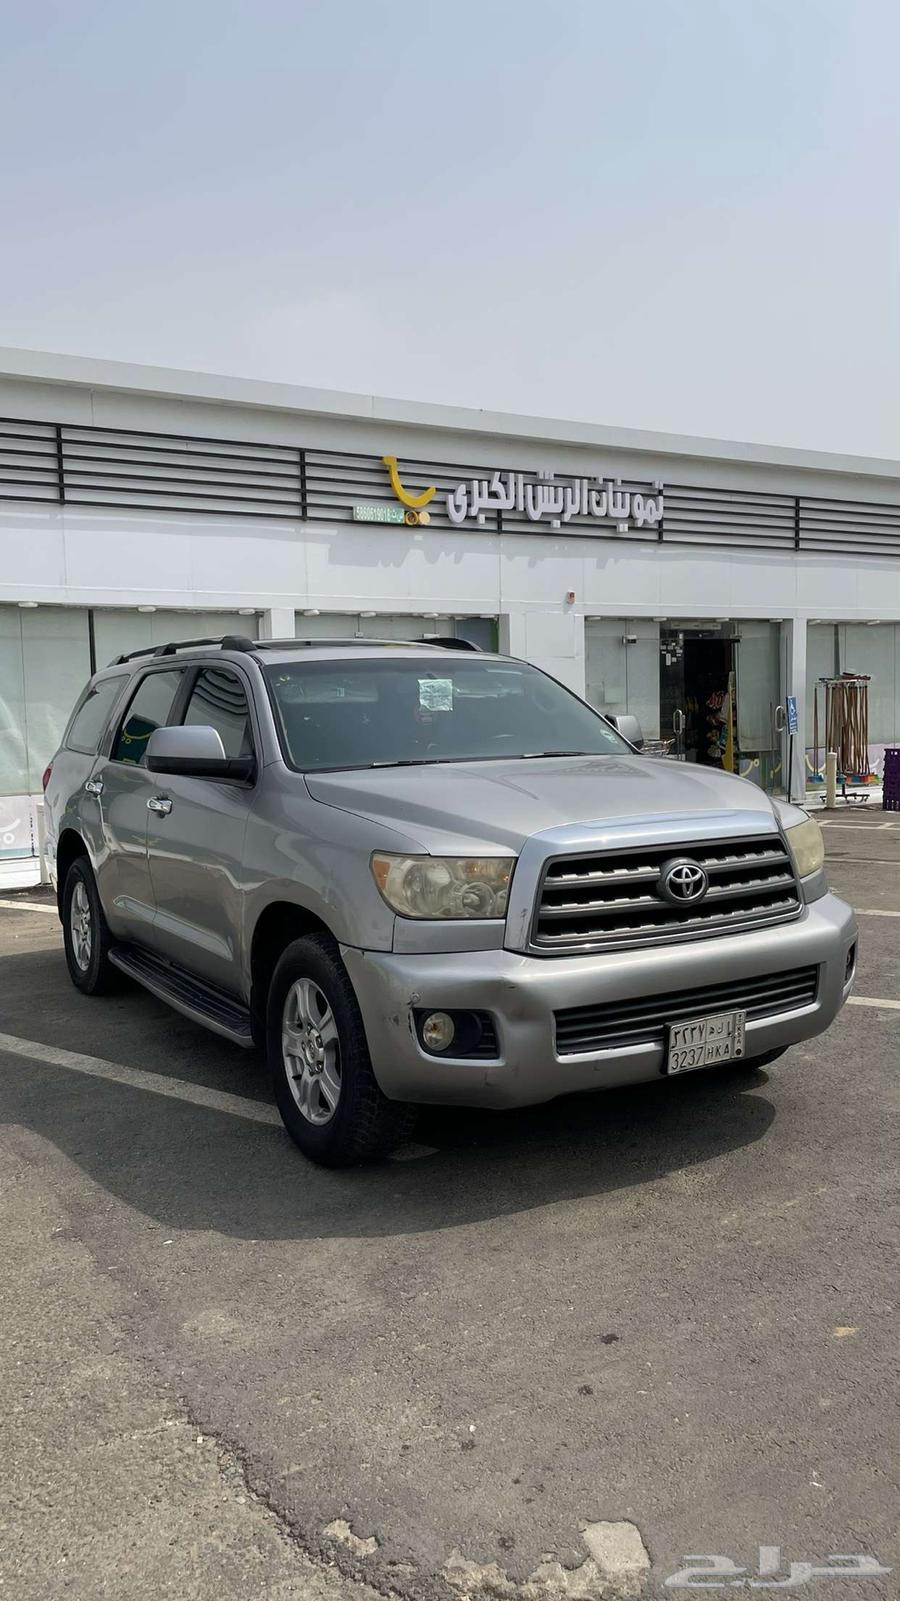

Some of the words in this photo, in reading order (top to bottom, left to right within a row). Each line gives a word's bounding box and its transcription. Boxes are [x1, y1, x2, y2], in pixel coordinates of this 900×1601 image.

[447, 472, 524, 524] الكبرى
[589, 476, 664, 532] تموينات
[671, 1046, 704, 1070] 3237
[707, 1043, 730, 1060] HKA
